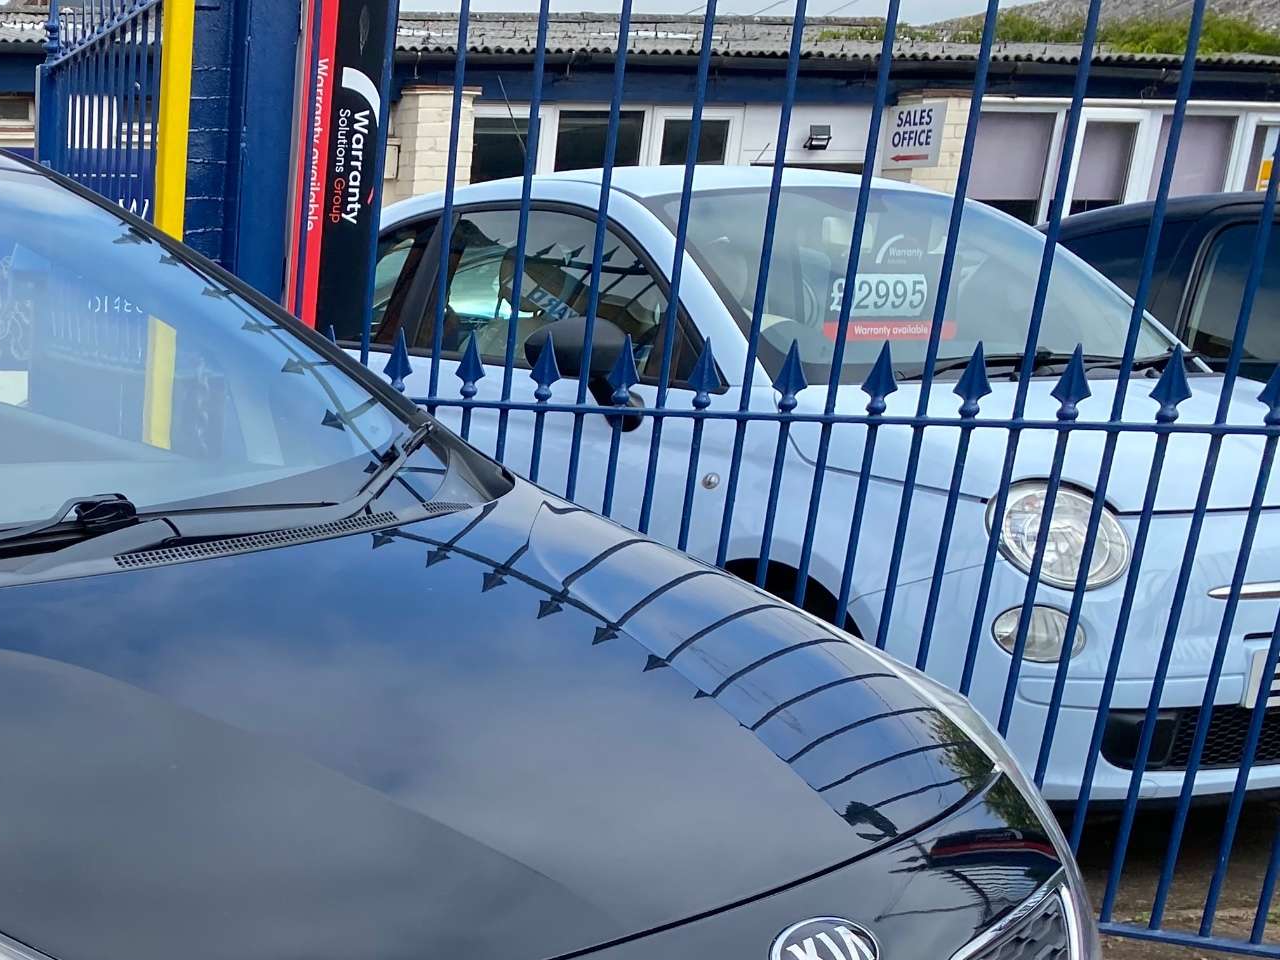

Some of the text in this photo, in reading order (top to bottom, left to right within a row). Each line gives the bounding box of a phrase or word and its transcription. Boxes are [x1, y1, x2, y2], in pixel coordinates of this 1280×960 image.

[307, 58, 330, 231] Warranty available
[892, 129, 932, 148] OFFICE
[897, 108, 933, 127] SALES
[329, 108, 351, 223] Solutions Group
[342, 110, 370, 224] Warranty
[854, 324, 929, 336] Warranty available
